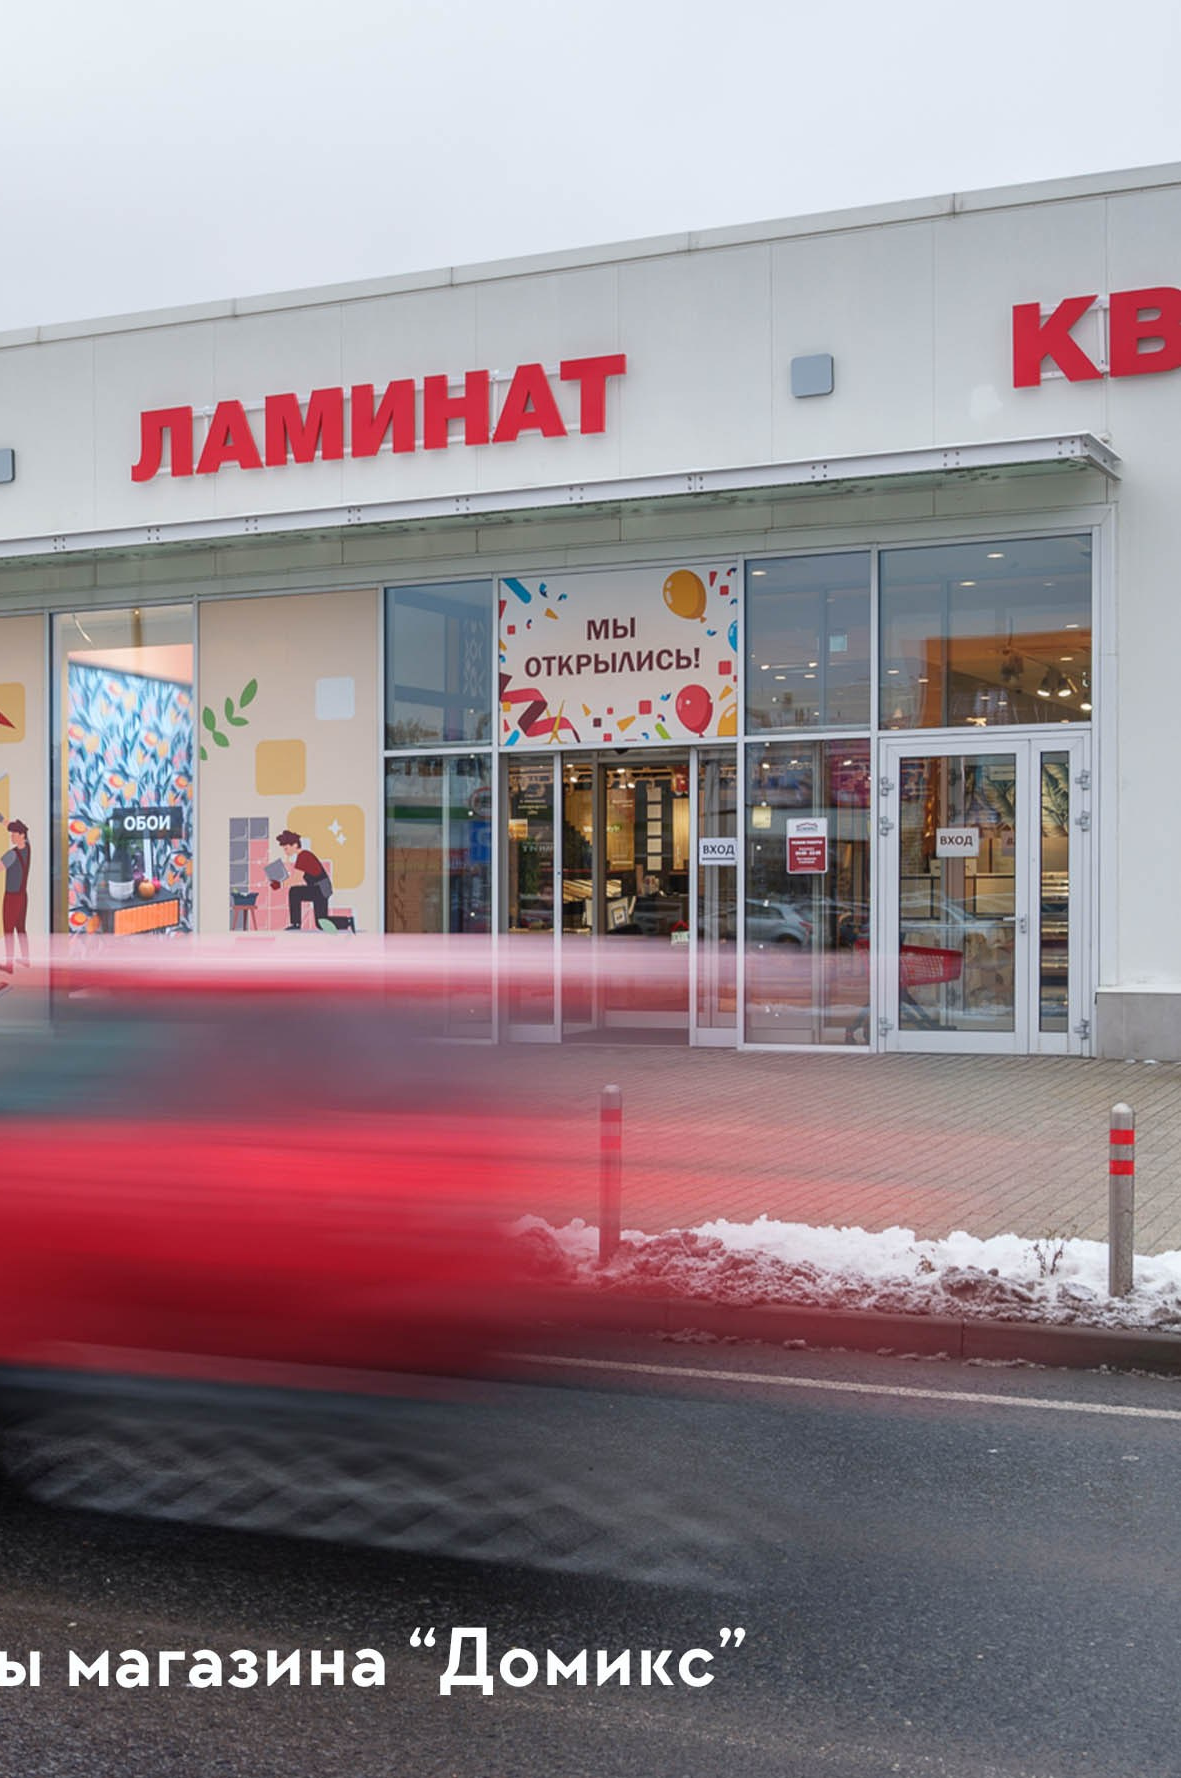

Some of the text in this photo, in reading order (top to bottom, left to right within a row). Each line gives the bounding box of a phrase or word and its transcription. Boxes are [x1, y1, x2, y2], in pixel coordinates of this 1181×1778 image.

[1012, 286, 1181, 388] КВ
[131, 353, 627, 483] ЛАМИНАТ
[586, 617, 635, 641] МЫ
[524, 648, 700, 678] ОТКРЫЛИСЬ!
[123, 814, 171, 831] ОБОИ
[702, 844, 735, 856] ВХОД
[939, 835, 974, 847] ВХОД
